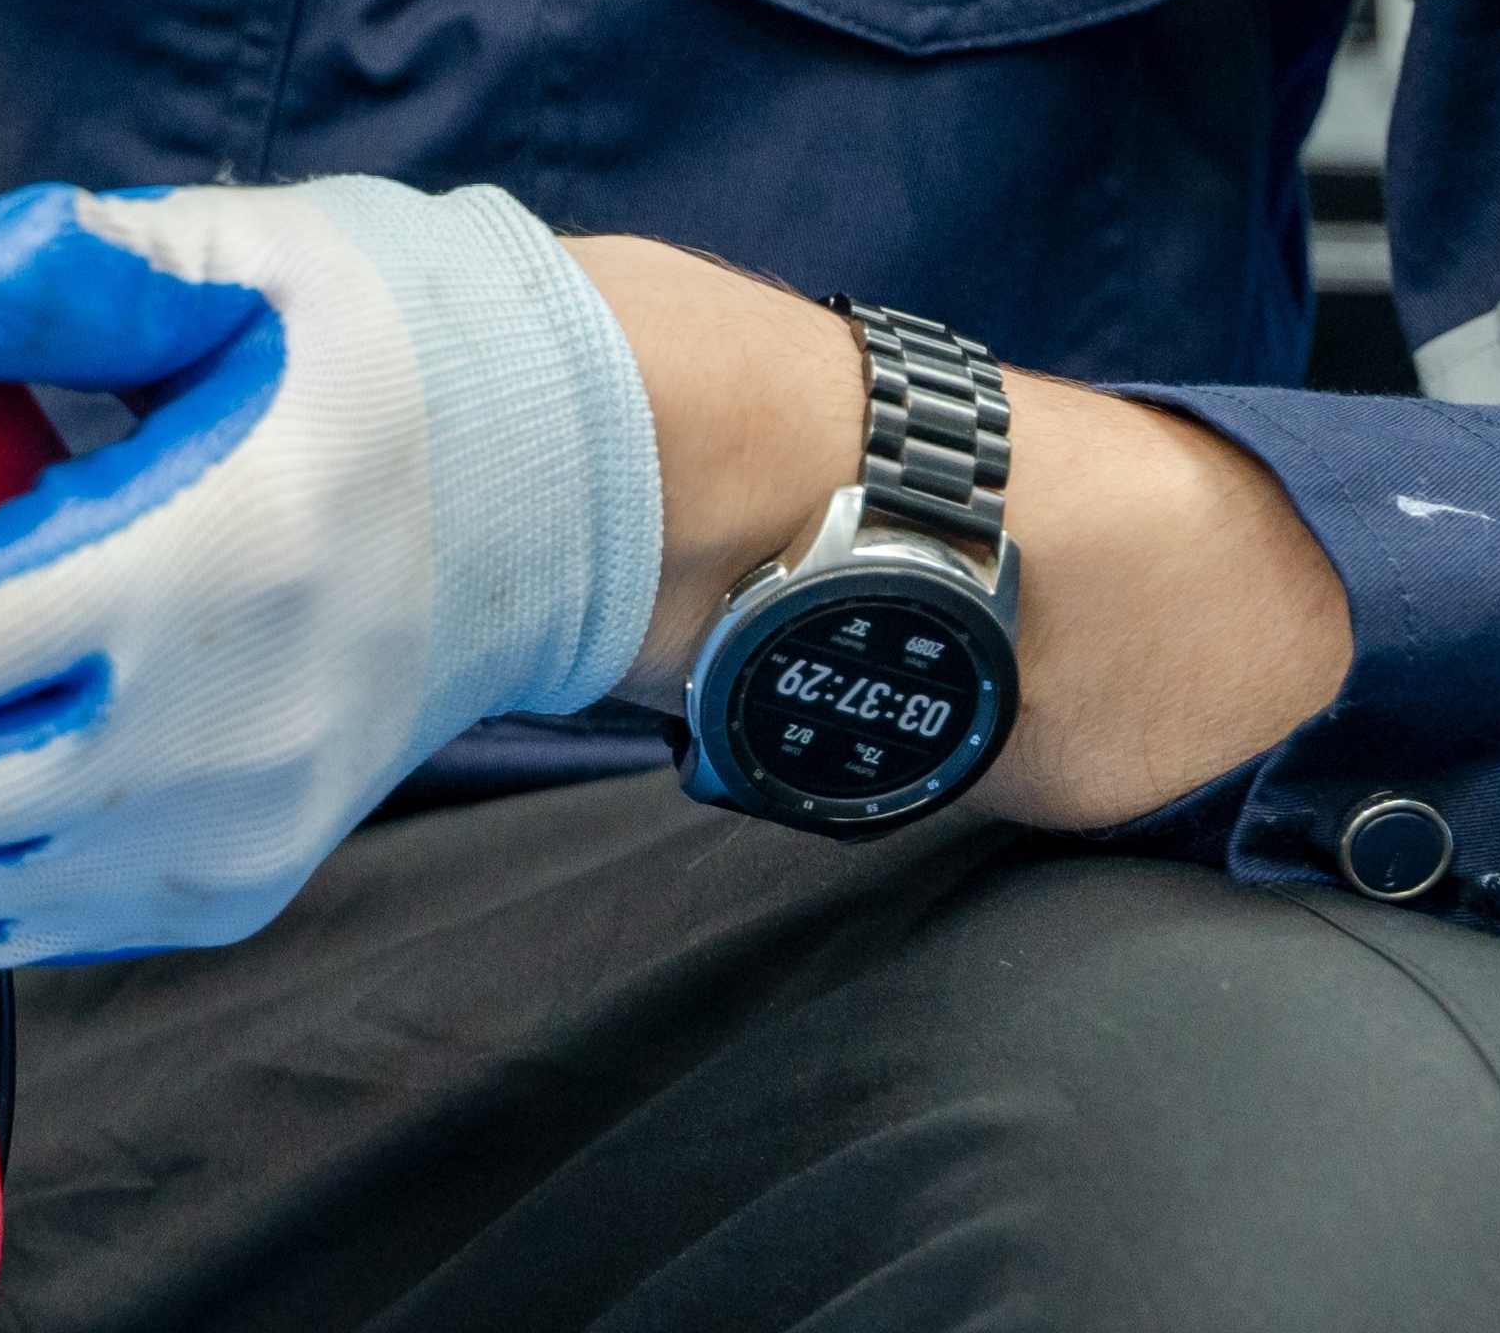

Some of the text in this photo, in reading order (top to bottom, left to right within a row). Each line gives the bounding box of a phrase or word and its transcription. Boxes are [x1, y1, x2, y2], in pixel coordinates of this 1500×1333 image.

[905, 636, 945, 659] 2089
[776, 659, 951, 736] 03:37:29
[784, 723, 814, 744] 8/2
